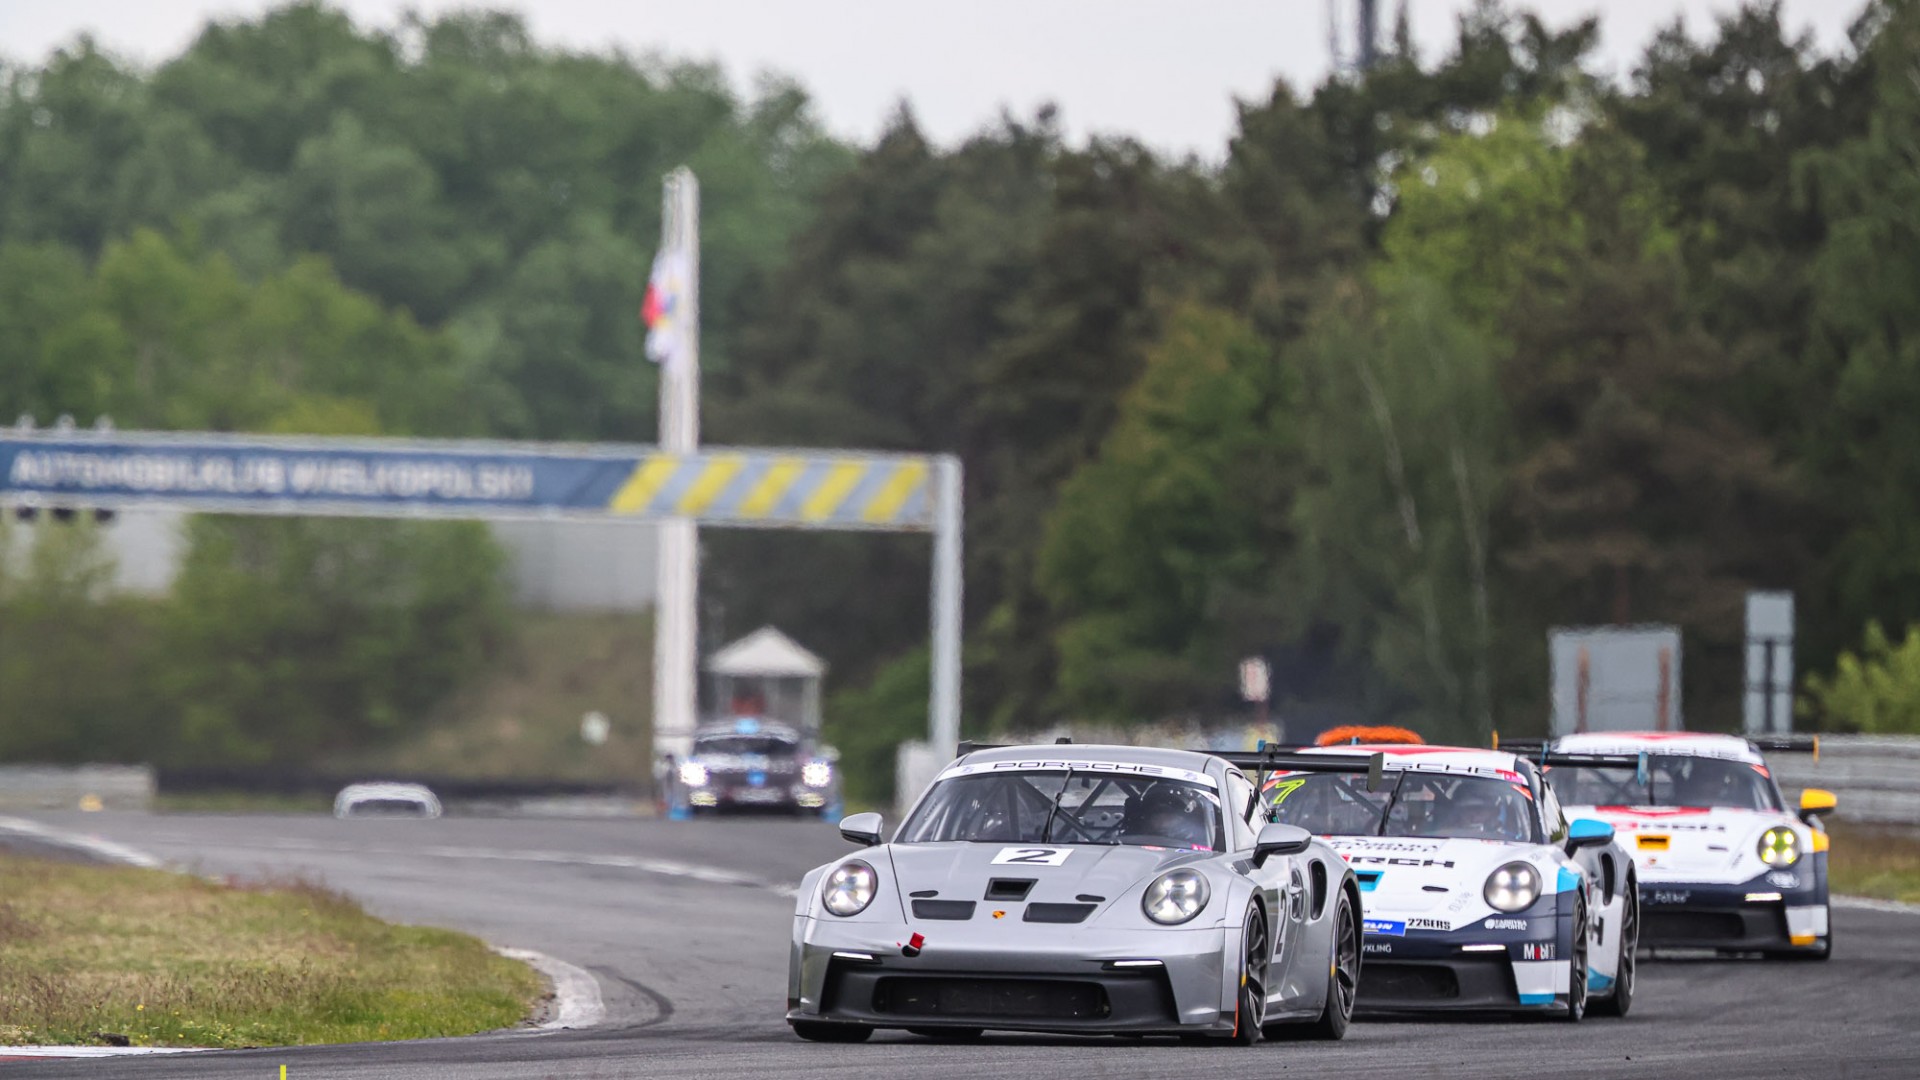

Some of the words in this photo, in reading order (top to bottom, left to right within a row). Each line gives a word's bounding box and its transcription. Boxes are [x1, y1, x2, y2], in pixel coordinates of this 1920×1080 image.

[10, 451, 286, 491] AUTOMOBILKLUB
[290, 457, 532, 499] WIELKOPOLSKI
[993, 762, 1163, 775] PORSCHE
[1386, 762, 1500, 776] SCHE
[1274, 779, 1305, 804] 7
[1006, 850, 1056, 862] 2
[1351, 856, 1455, 868] RCH
[1275, 888, 1287, 955] 2
[1408, 918, 1451, 930] 226ERS
[1362, 943, 1392, 953] YKLING
